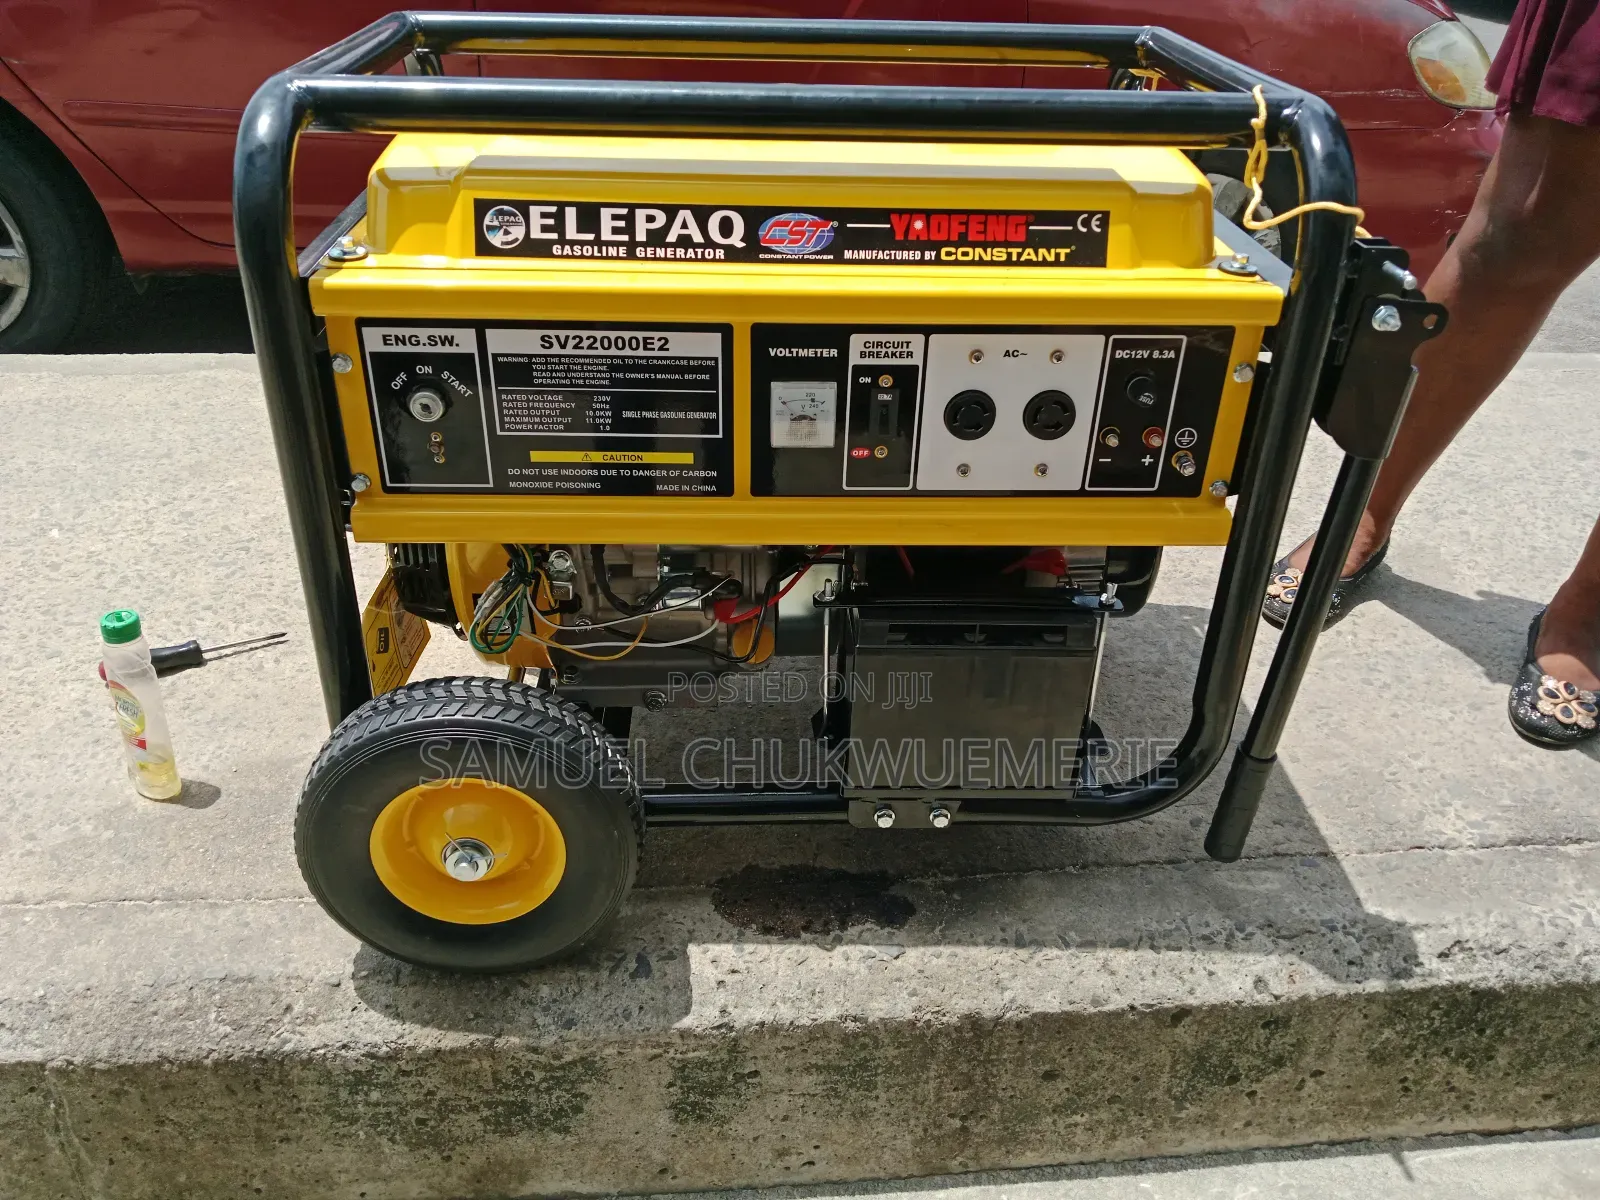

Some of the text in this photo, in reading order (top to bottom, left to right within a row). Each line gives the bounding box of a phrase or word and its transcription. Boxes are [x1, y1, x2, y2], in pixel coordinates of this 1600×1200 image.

[529, 206, 746, 248] ELEPAQ
[890, 214, 1027, 242] YAOFENG
[760, 220, 833, 246] CST
[552, 244, 725, 260] GASOLINE GENERATOR
[844, 247, 1071, 262] MANUFACTURED BY CONSTANT
[382, 334, 460, 347] ENG.SW.
[539, 334, 670, 352] SV22000E2
[863, 340, 912, 350] CIRCUIT
[769, 348, 838, 358] VOLTMETER
[859, 350, 914, 359] BREAKER
[1115, 350, 1175, 358] DC12V 8.3A
[416, 365, 432, 374] ON
[391, 372, 408, 390] OFF
[441, 370, 474, 397] START
[1138, 395, 1154, 405] FUSE
[622, 410, 641, 418] SINGLE
[660, 411, 685, 419] GASOLINE
[602, 454, 643, 462] CAUTION
[522, 468, 539, 476] NOT
[509, 481, 554, 489] MONOXIDE
